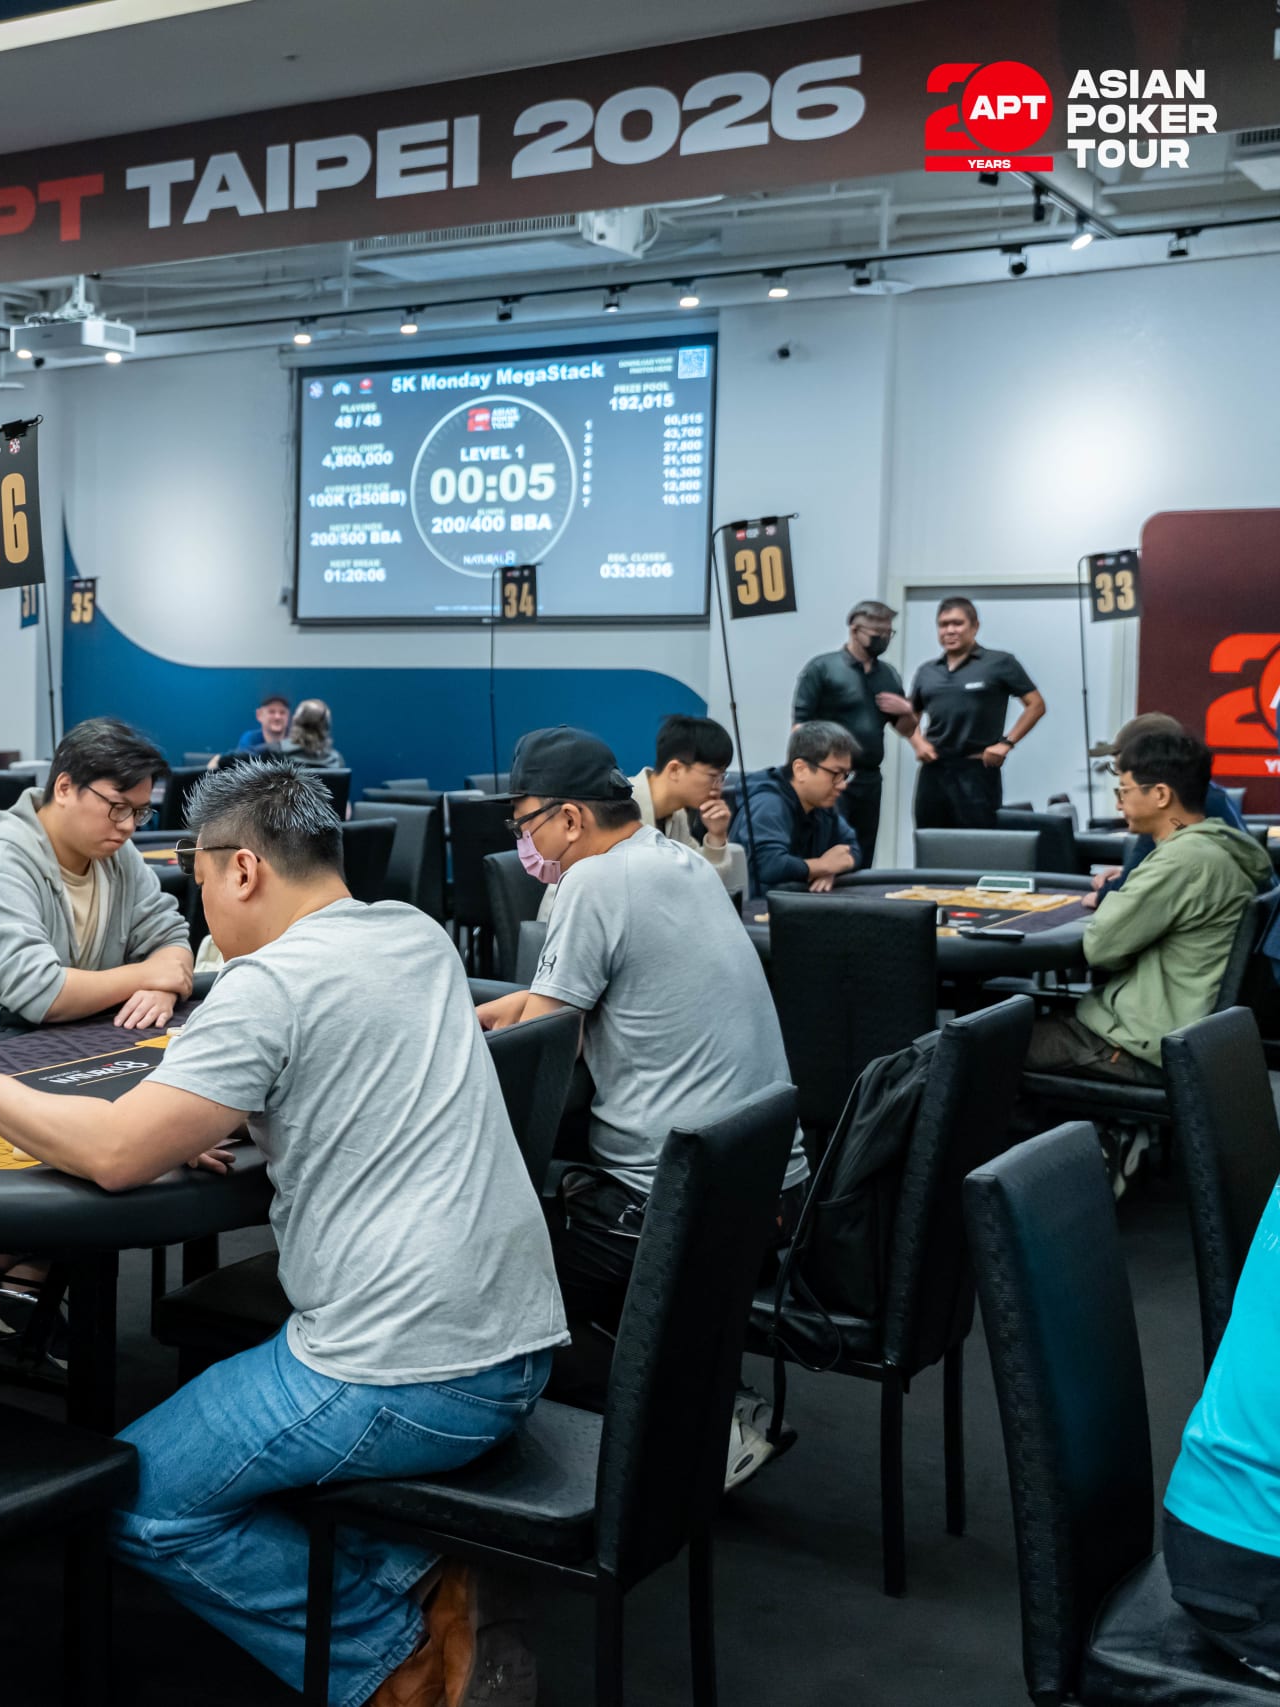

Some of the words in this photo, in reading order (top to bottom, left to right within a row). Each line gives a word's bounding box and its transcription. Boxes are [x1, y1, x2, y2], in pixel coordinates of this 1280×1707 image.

[125, 114, 480, 229] TAIPEI
[511, 54, 865, 179] 2026
[391, 375, 417, 393] 5K
[421, 371, 491, 391] Monday
[496, 361, 605, 386] MegaStack
[643, 381, 670, 393] POOL
[609, 392, 675, 412] 192,015
[584, 419, 593, 430] 1
[584, 432, 593, 444] 2
[321, 450, 394, 470] 4,800,000
[460, 445, 511, 462] LEVEL
[515, 444, 525, 459] 1
[583, 445, 592, 456] 3
[583, 458, 592, 469] 4
[430, 463, 557, 505] 00:05
[308, 493, 345, 507] 100K
[582, 497, 591, 508] 7
[431, 515, 505, 534] 200/400
[510, 513, 552, 532] BBA
[370, 529, 403, 545] BBA
[600, 562, 674, 578] 03:35:06
[734, 545, 787, 605] 30
[504, 582, 535, 619] 34
[1095, 569, 1136, 613] 33
[70, 591, 95, 624] 35
